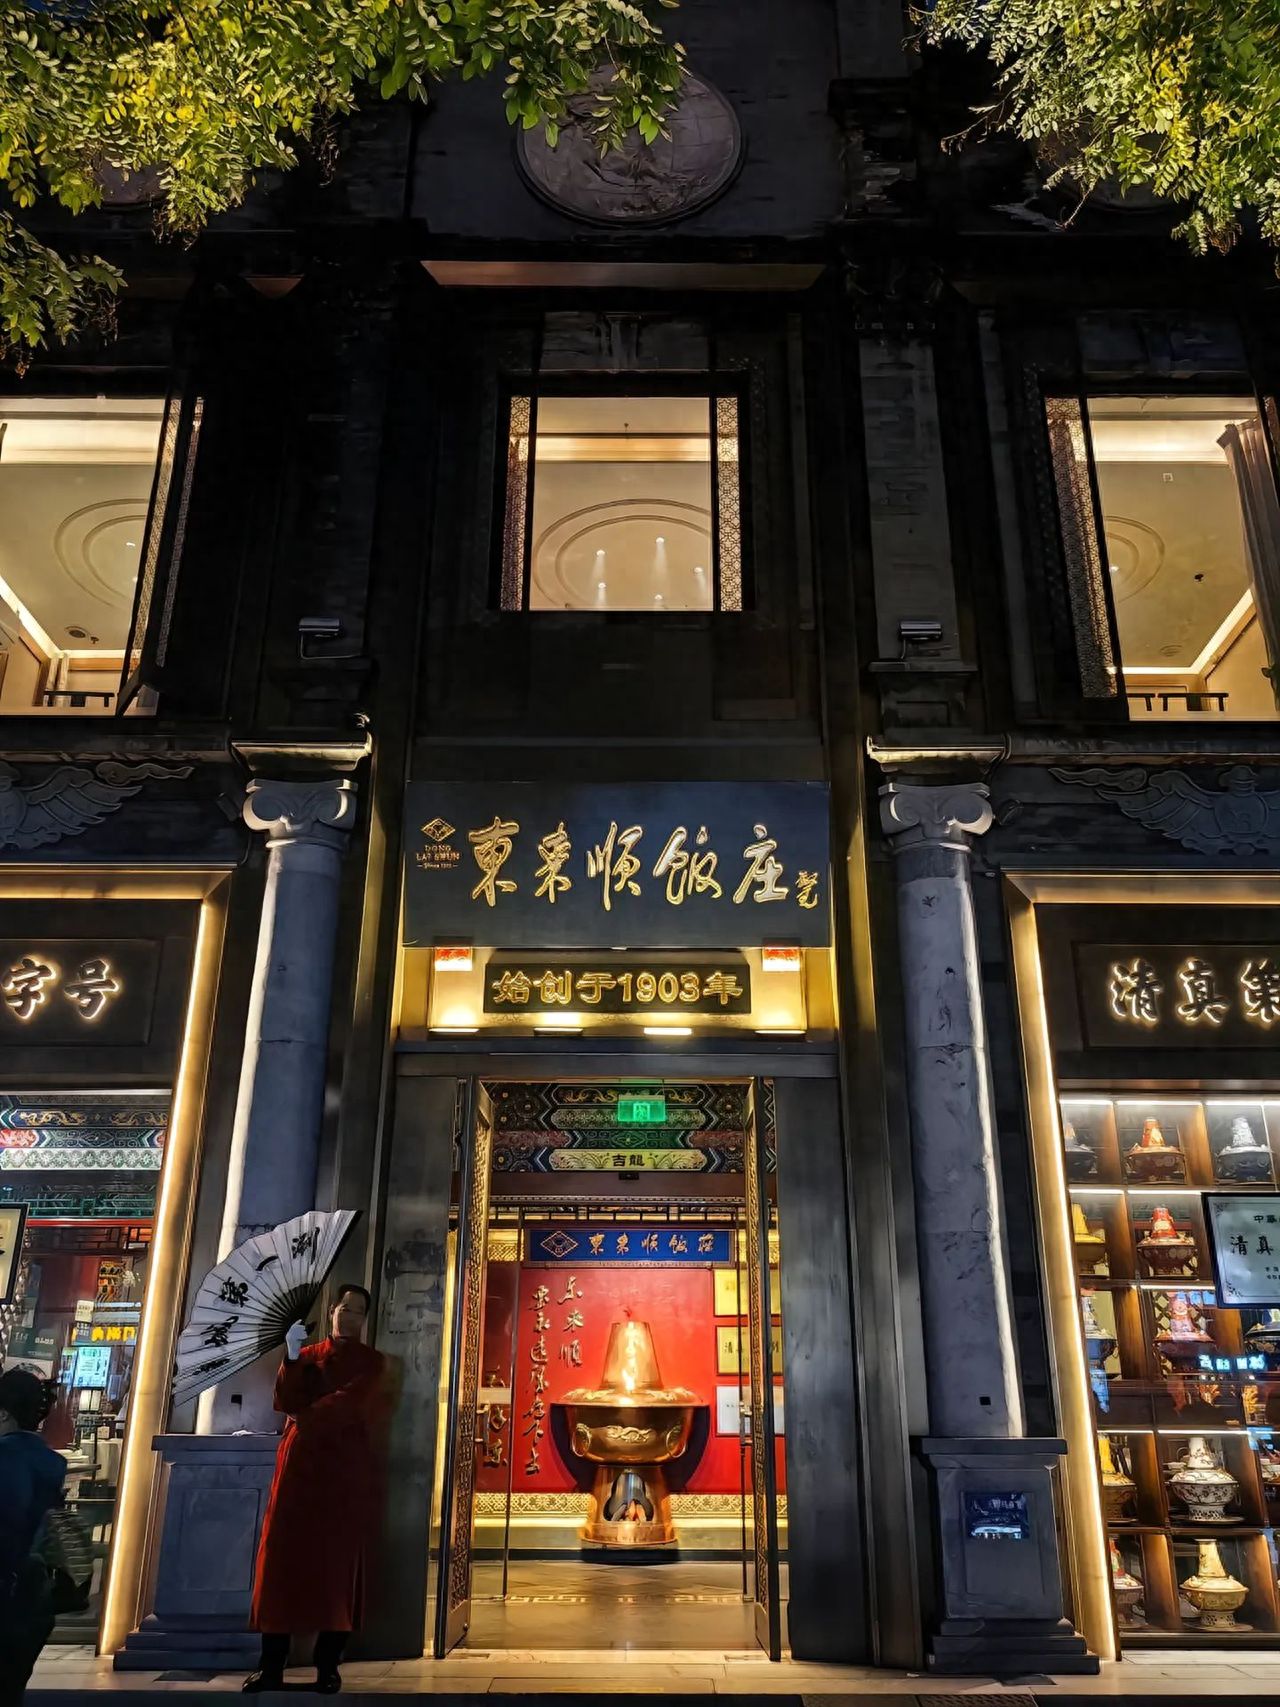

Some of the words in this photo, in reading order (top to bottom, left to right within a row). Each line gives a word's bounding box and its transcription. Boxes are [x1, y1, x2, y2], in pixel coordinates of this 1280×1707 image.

[416, 853, 431, 861] LAI
[434, 853, 459, 861] SHUN
[1, 957, 119, 1019] 字号
[492, 970, 744, 1005] 始创于1903年
[1230, 1234, 1274, 1256] 清真
